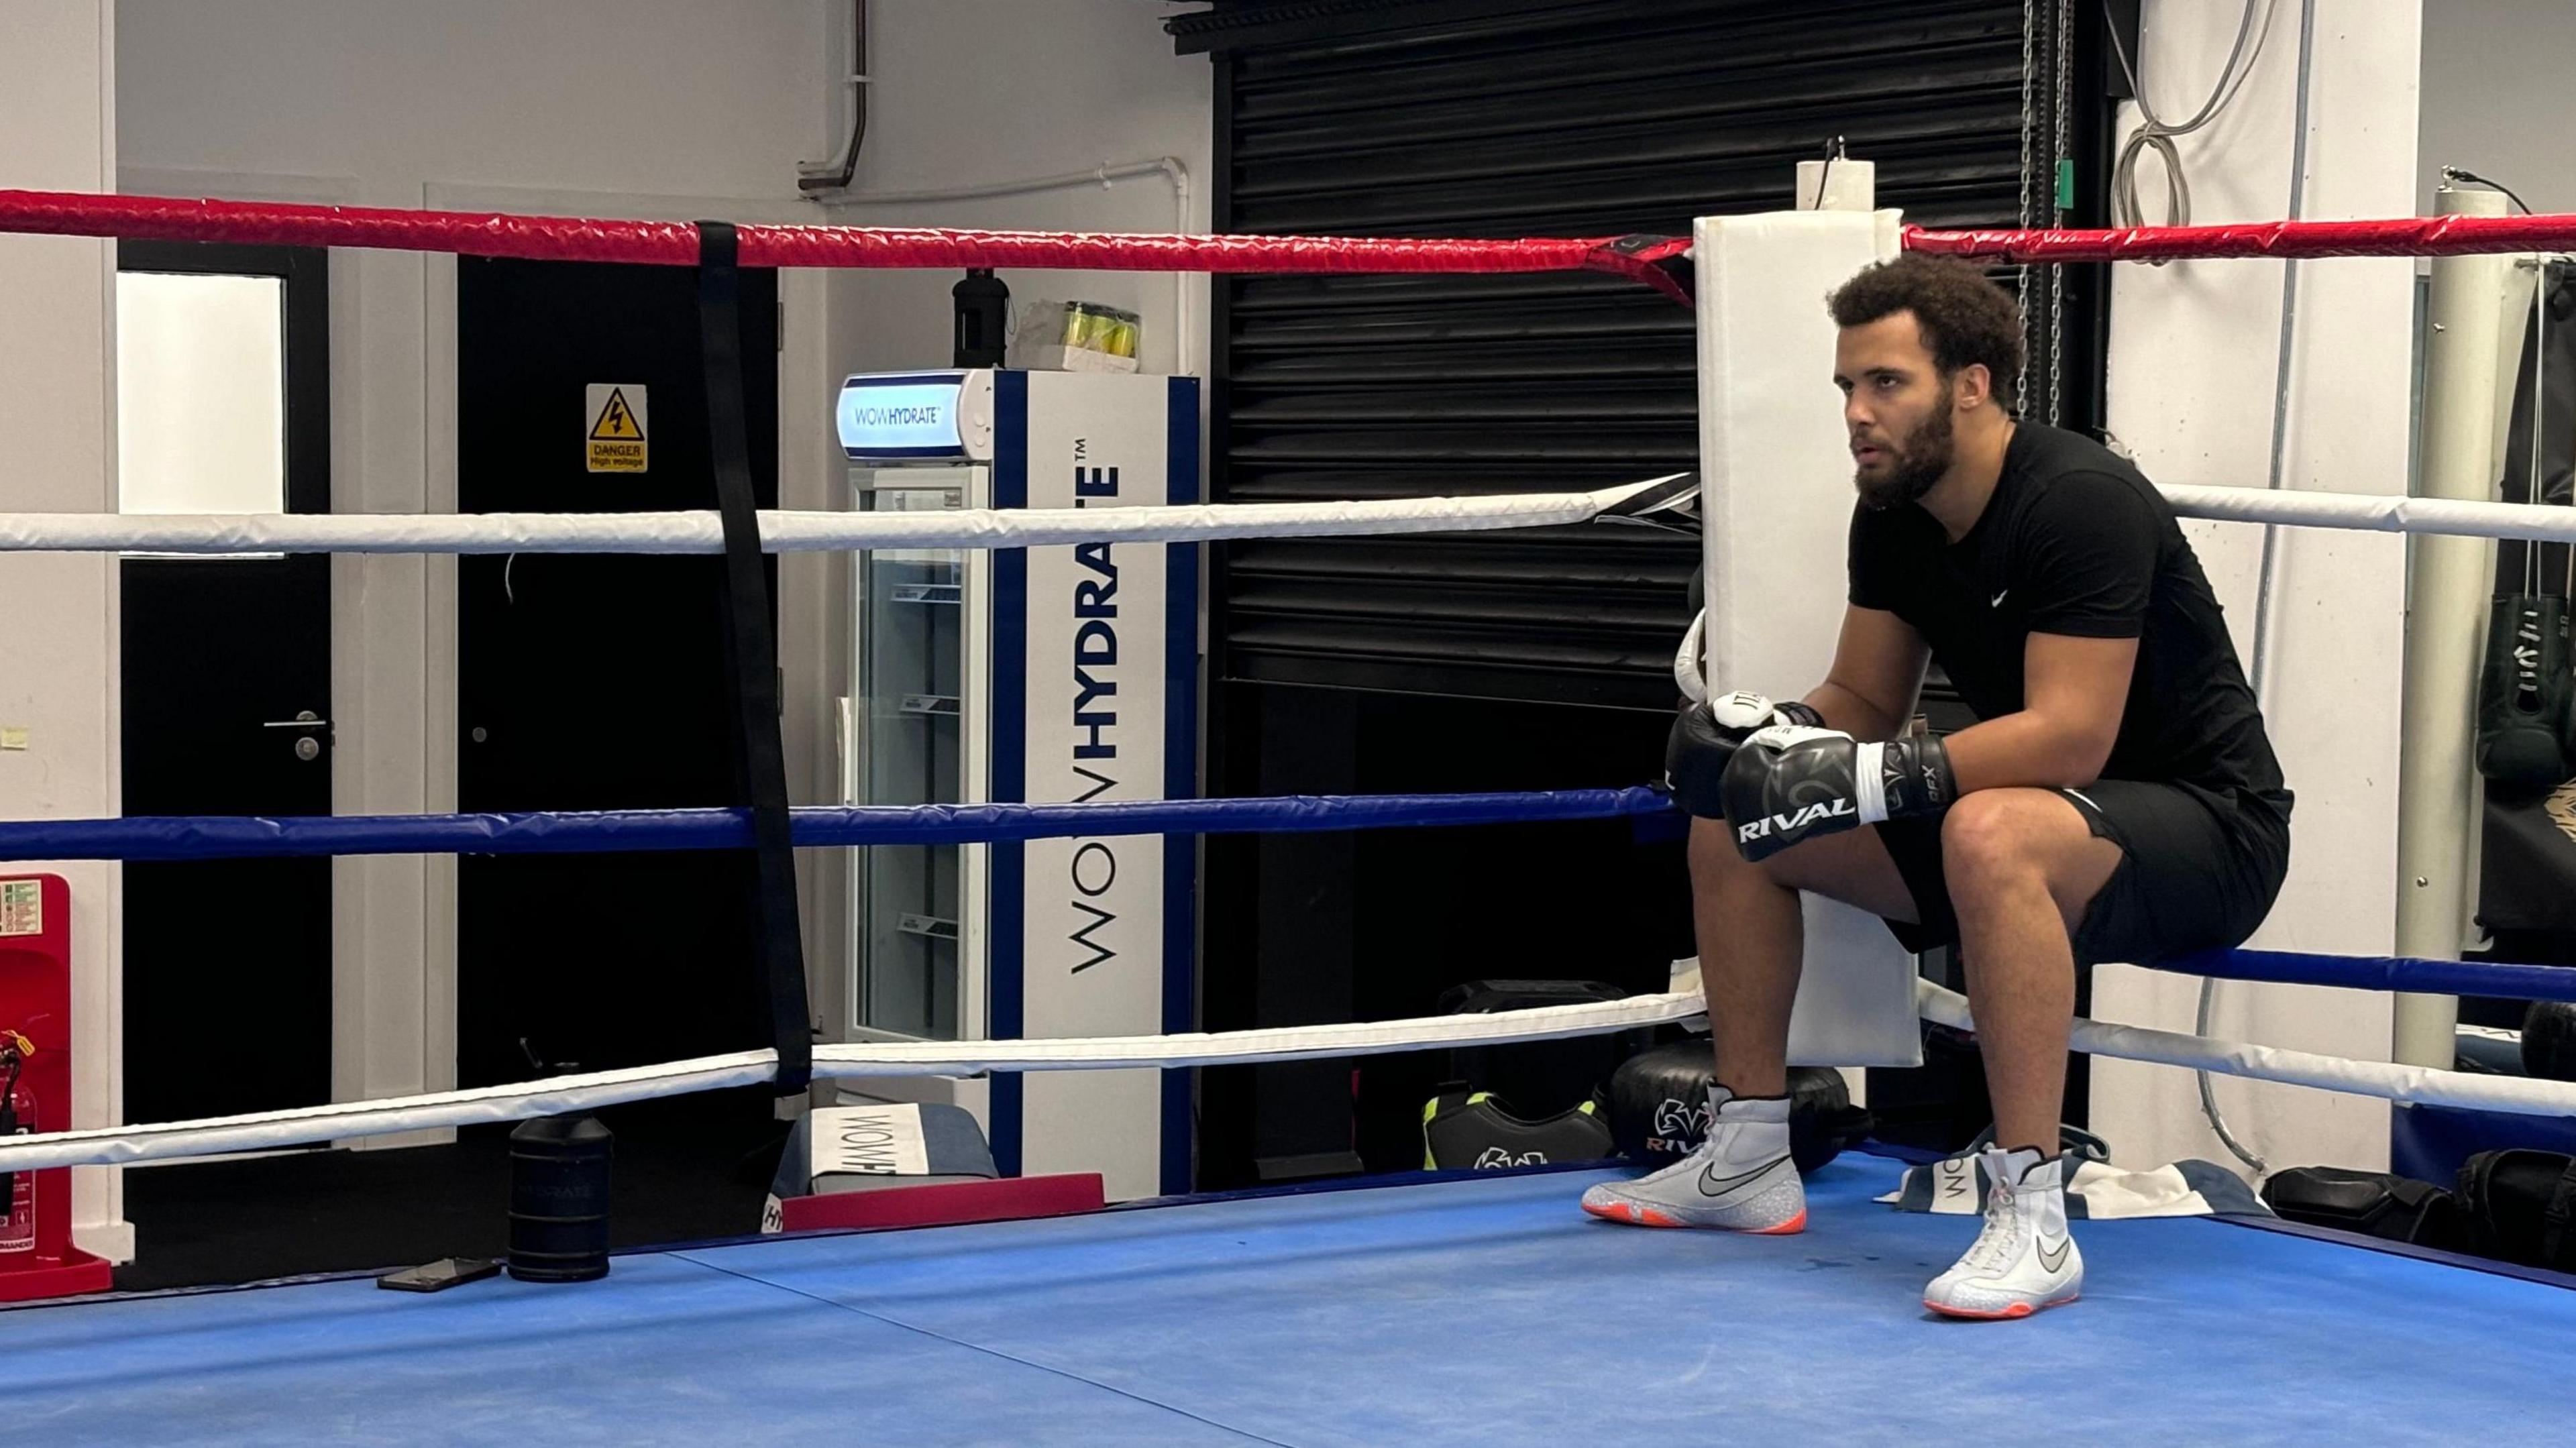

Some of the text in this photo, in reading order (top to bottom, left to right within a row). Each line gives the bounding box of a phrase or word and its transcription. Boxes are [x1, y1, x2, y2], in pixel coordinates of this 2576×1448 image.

[594, 445, 641, 456] DANGER
[590, 457, 643, 468] High voltage
[1738, 797, 1856, 844] RIVAL
